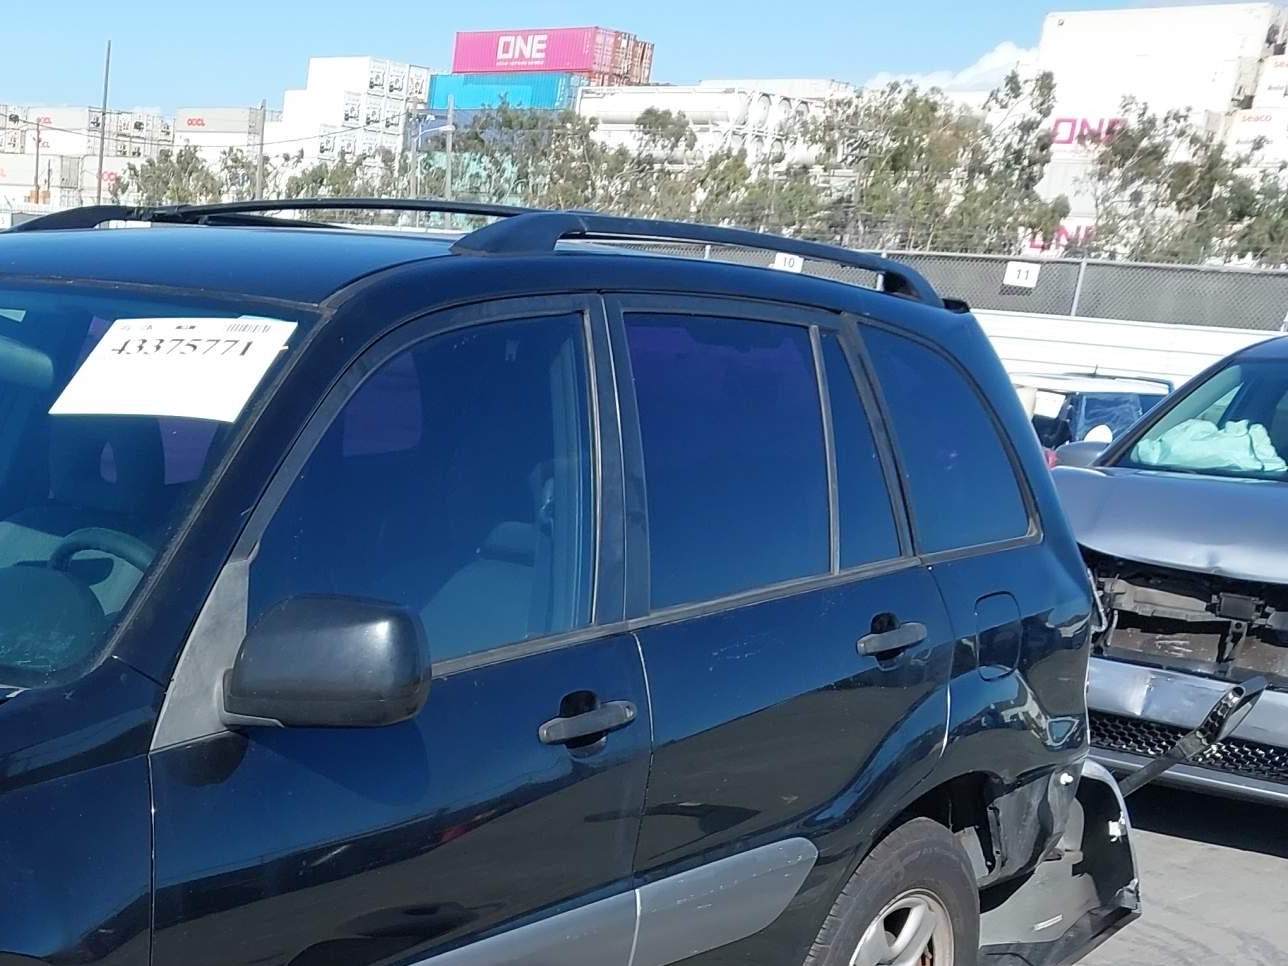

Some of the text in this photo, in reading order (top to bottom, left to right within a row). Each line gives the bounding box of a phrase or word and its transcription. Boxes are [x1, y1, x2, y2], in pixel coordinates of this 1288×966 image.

[496, 34, 548, 60] ONE
[187, 118, 206, 127] OOCL
[782, 256, 795, 268] 10
[1016, 268, 1030, 281] 11
[112, 338, 253, 356] 43375771
